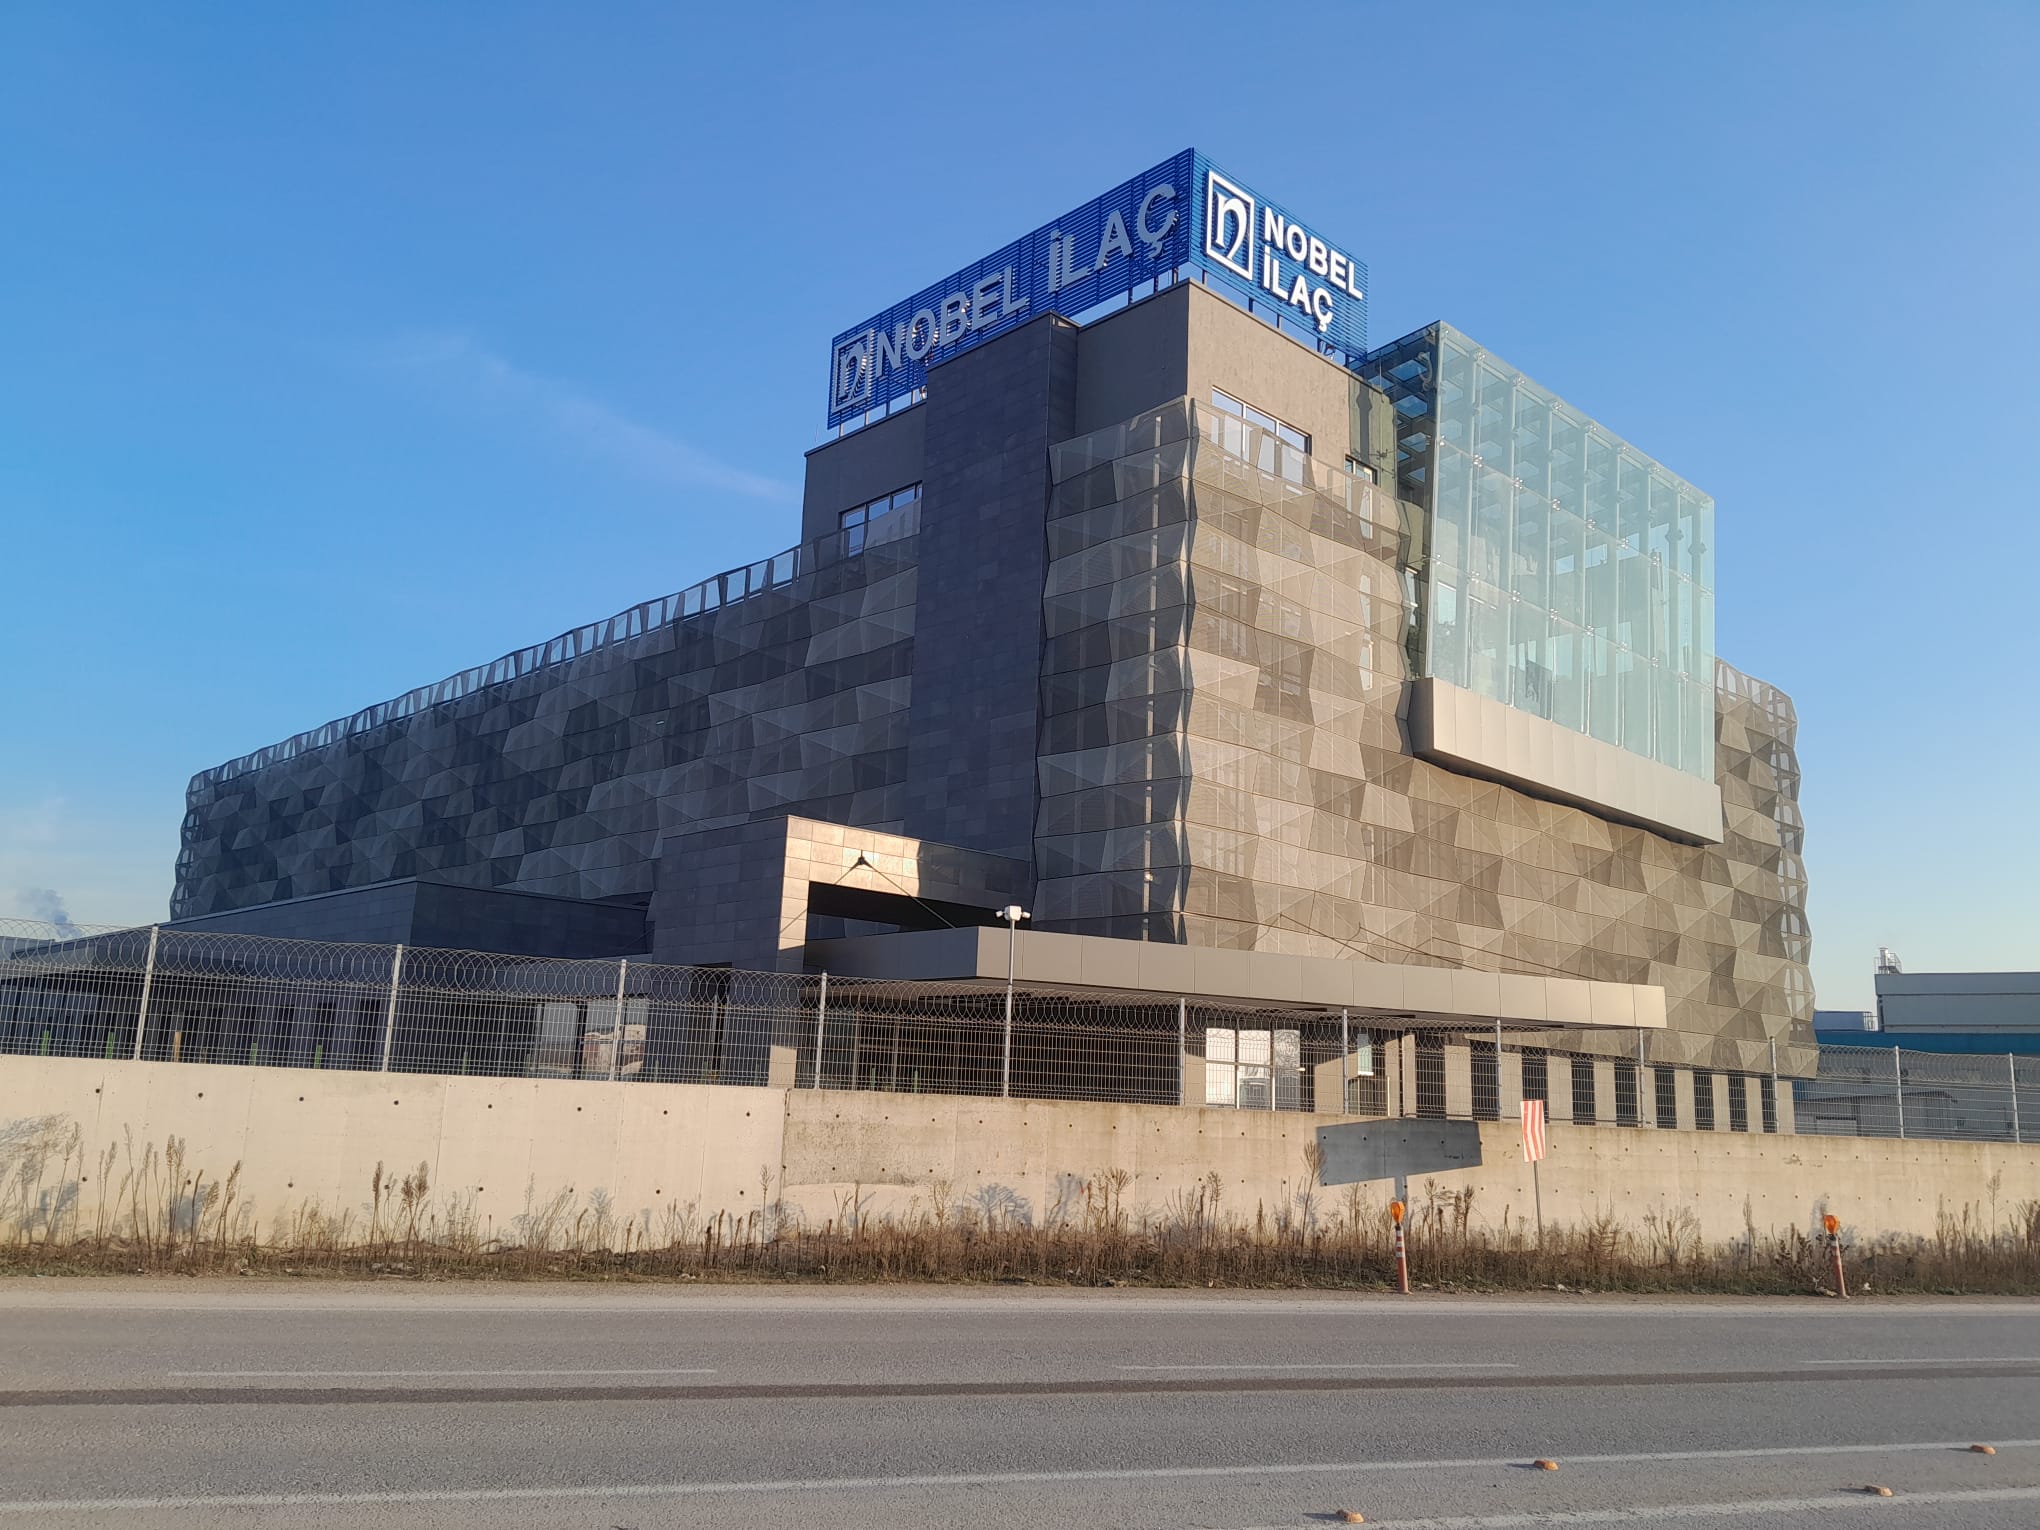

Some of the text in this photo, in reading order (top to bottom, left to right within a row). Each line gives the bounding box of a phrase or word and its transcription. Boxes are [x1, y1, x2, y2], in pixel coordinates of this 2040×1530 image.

[876, 266, 1029, 377] NOBEL
[1049, 183, 1179, 293] İLAÇ
[1263, 246, 1333, 332] İLAÇ
[1265, 206, 1363, 300] NOBEL
